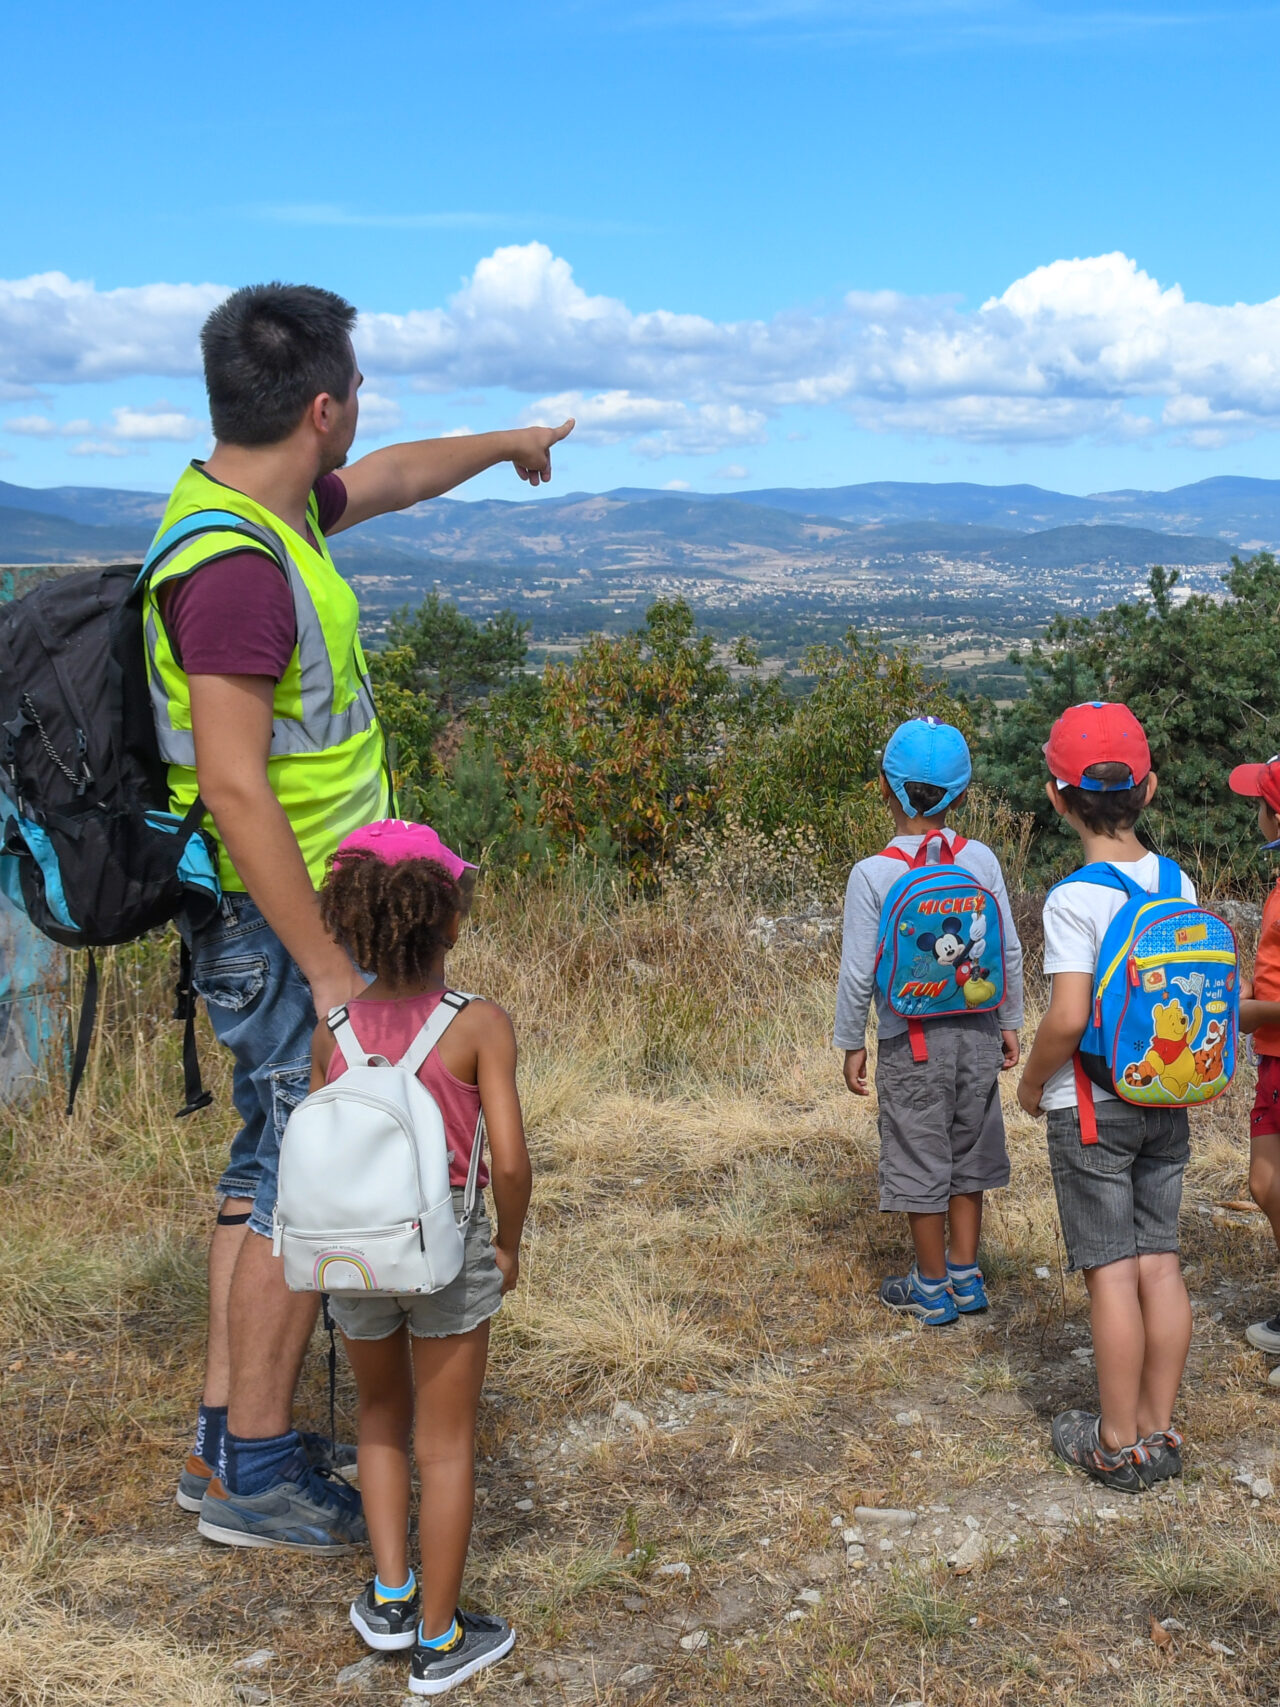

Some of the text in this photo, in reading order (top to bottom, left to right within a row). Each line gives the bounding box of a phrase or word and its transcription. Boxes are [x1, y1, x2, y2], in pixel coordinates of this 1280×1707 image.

[918, 896, 986, 915] MICKEY
[897, 979, 948, 998] FUN
[1205, 979, 1210, 988] A
[1206, 989, 1222, 999] well
